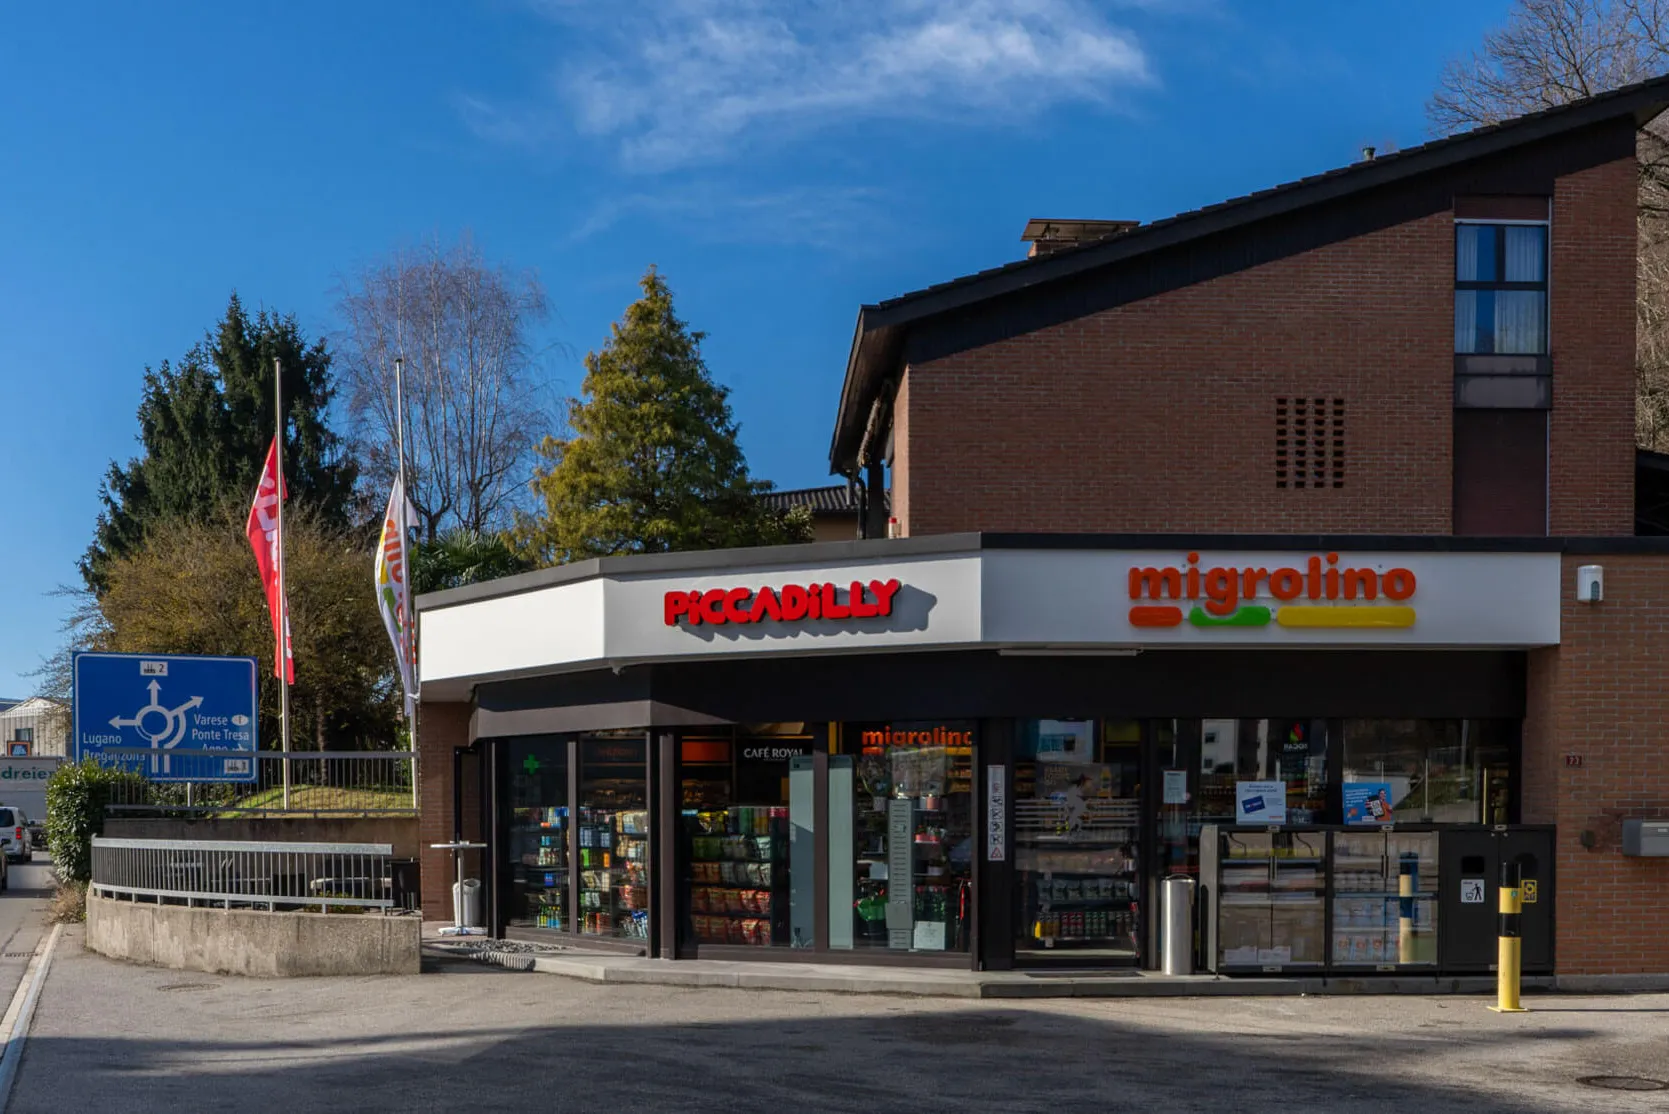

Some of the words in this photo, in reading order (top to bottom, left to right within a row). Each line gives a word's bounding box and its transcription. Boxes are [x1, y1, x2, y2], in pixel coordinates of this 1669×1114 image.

[1128, 552, 1416, 616] migrolino
[194, 714, 228, 726] Varese
[83, 732, 122, 747] Lugano
[192, 728, 221, 741] Ponte
[223, 729, 250, 741] Tresa
[743, 746, 770, 758] CAFÉ
